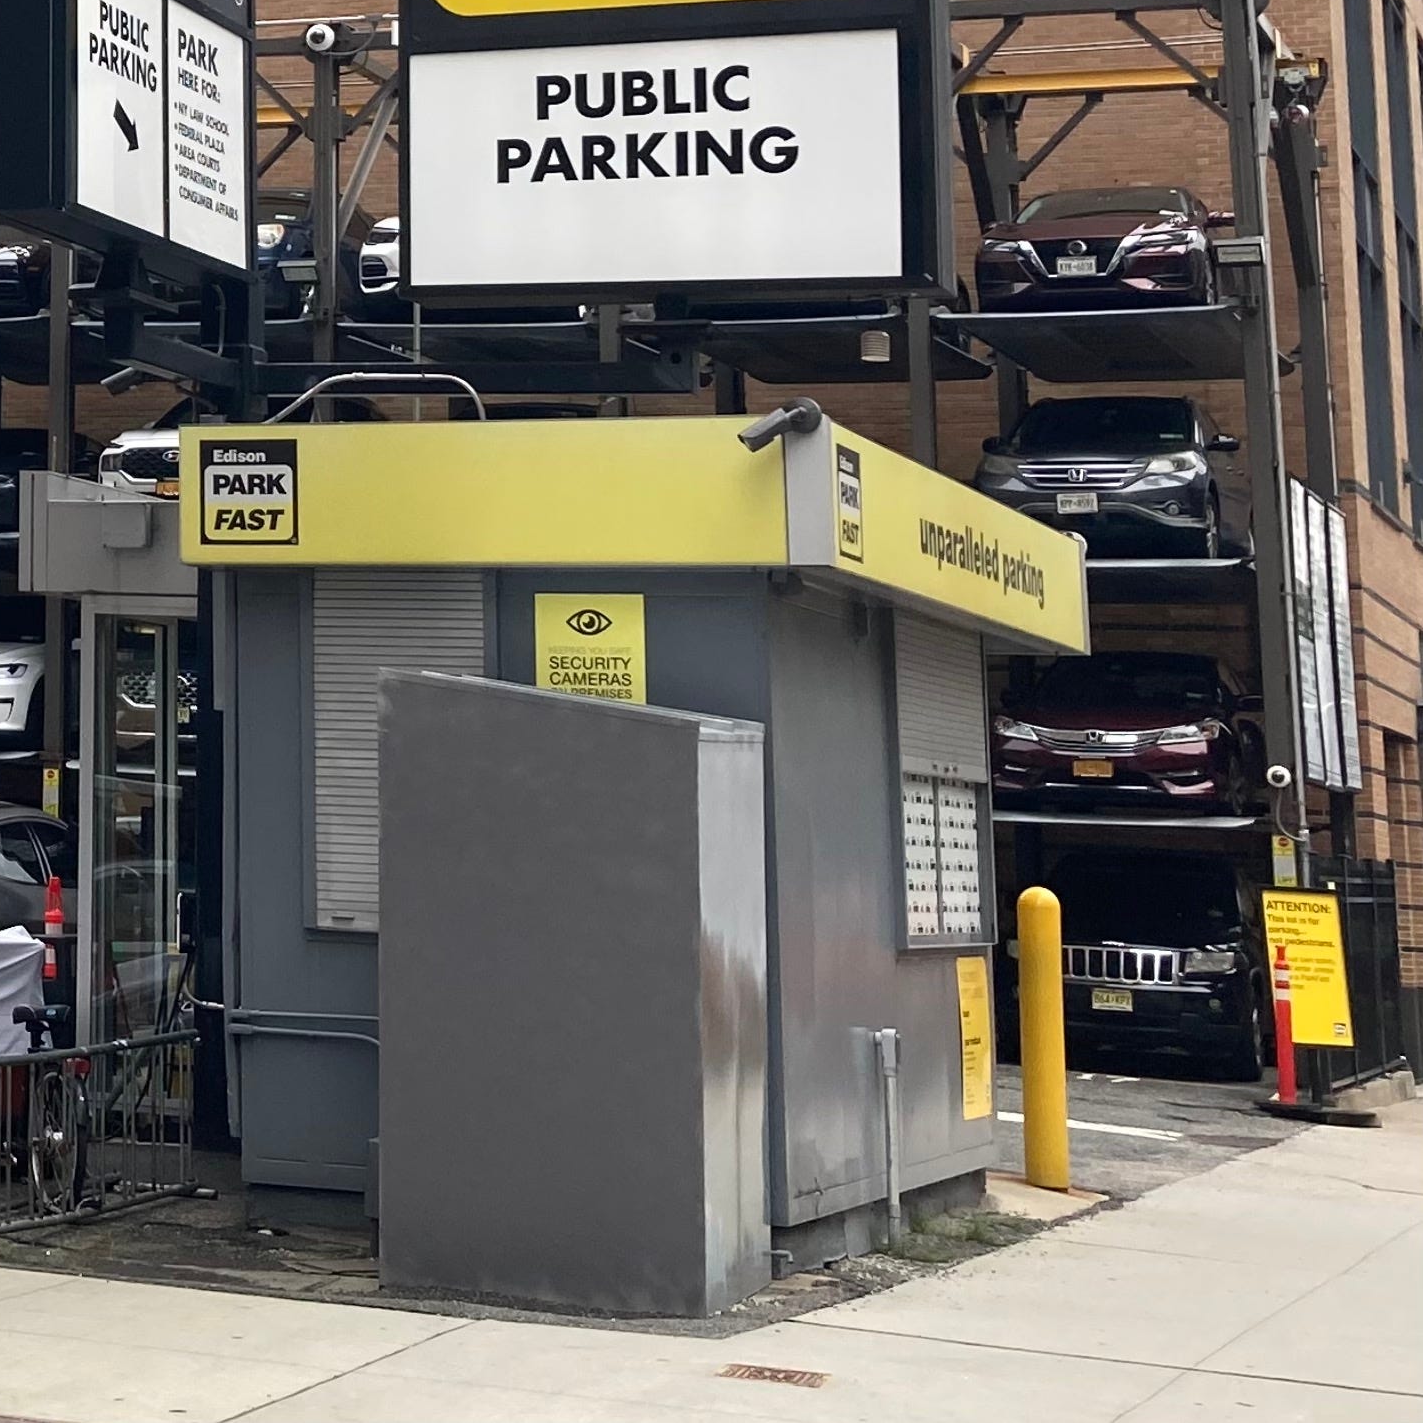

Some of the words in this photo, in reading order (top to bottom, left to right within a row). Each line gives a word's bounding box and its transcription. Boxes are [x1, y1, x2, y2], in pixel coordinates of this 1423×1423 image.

[99, 0, 149, 53] PUBLIC
[89, 32, 157, 92] PARKING
[178, 28, 218, 76] PARK
[178, 67, 199, 93] HERE
[536, 65, 750, 120] PUBLIC
[179, 143, 196, 161] AREA
[497, 126, 799, 184] PARKING
[212, 449, 266, 463] Edison
[213, 473, 287, 495] PARK
[840, 481, 860, 509] PARK
[214, 508, 285, 531] FAST
[842, 519, 859, 545] FAST
[919, 518, 999, 583] unparalleled
[1002, 550, 1045, 610] parking
[549, 656, 631, 670] SECURITY
[549, 672, 632, 686] CAMERAS
[1266, 900, 1331, 914] ATTENTION:
